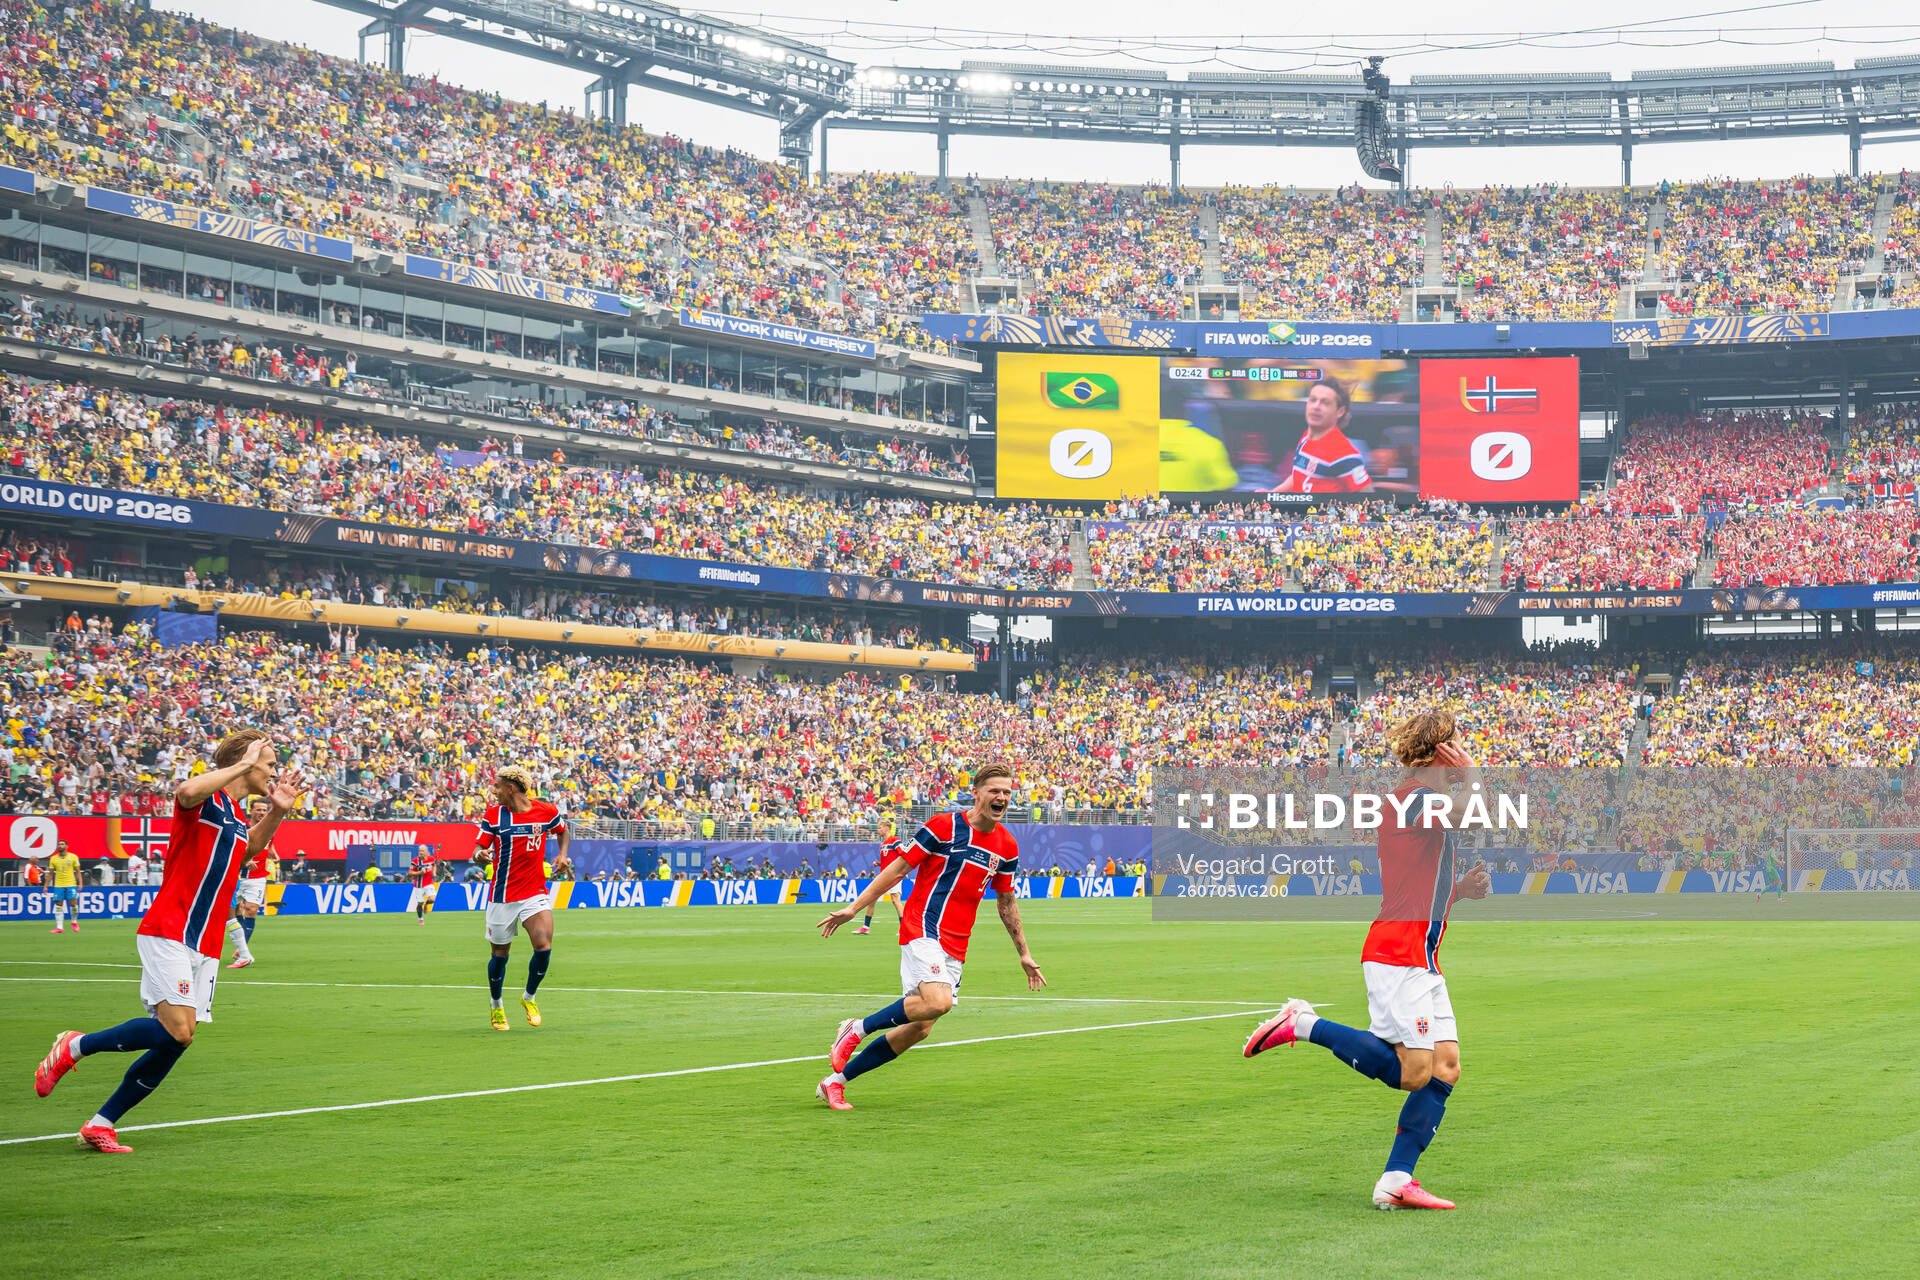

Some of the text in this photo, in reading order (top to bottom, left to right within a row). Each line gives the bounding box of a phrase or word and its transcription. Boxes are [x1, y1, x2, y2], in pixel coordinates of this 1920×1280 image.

[728, 320, 770, 336] YORK
[773, 328, 807, 342] NEW
[810, 337, 867, 353] JERSEY
[1205, 333, 1372, 346] FIFA WOR CUP 2026
[1175, 368, 1203, 378] 02:42
[0, 483, 192, 524] ORLD CUP 2026
[1267, 492, 1313, 502] Hisense
[337, 526, 516, 559] NEW YORK NEW JERSEY
[699, 566, 760, 586] #FIFAWorldCup
[923, 588, 949, 602] NEW
[951, 592, 982, 605] YORK
[1016, 597, 1073, 609] JERSEY
[1198, 598, 1396, 612] FIFA WORLD CUP 2026
[1519, 596, 1683, 610] NEW YORK NEW JERSEY
[329, 829, 417, 851] NORWAY
[815, 879, 858, 903] VISA
[1013, 877, 1032, 899] SA
[1076, 877, 1115, 898] VISA
[1308, 874, 1364, 896] VISA
[1569, 872, 1629, 894] VISA
[1706, 870, 1766, 892] VISA
[1847, 869, 1911, 891] VISA
[27, 891, 105, 915] STES
[108, 891, 135, 914] OF
[308, 884, 377, 914] VISA
[460, 883, 490, 911] VI
[592, 881, 645, 908] VISA
[710, 880, 758, 905] VISA
